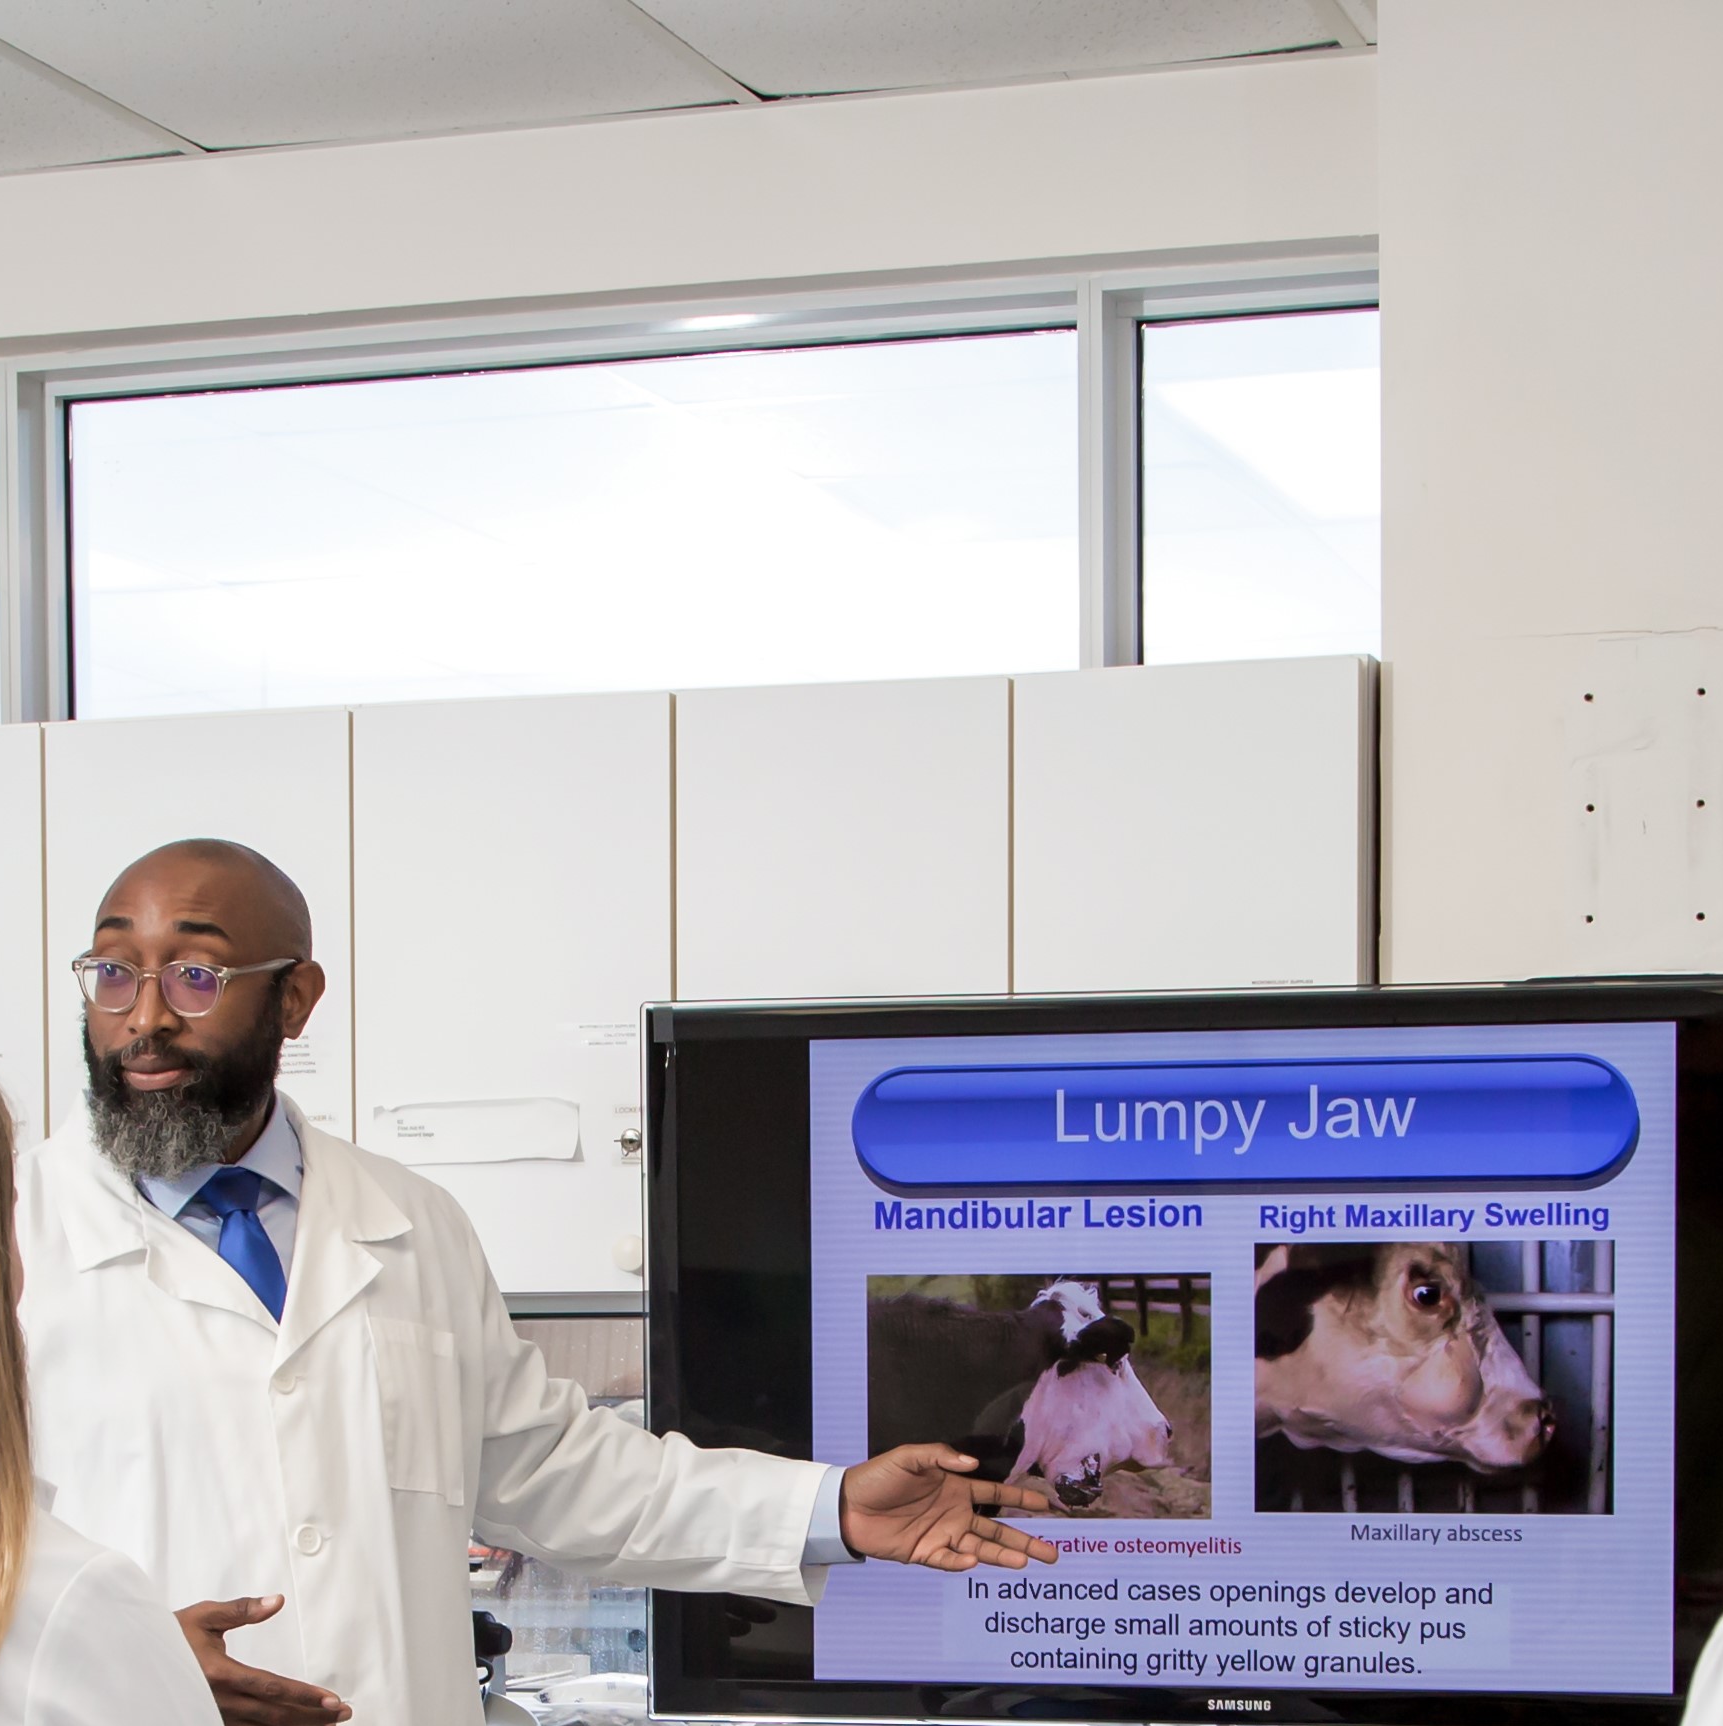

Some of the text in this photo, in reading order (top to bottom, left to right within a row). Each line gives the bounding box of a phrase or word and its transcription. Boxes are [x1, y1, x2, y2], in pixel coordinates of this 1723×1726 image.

[1056, 1084, 1417, 1155] Lumpy Jaw
[874, 1198, 1203, 1230] Mandibular Lesion
[1259, 1202, 1610, 1234] Right Maxillary Swelling
[1114, 1536, 1242, 1558] osteomyelitis
[1351, 1523, 1523, 1545] Maxillary abscess
[967, 1577, 1493, 1610] In advanced cases openings develop and
[984, 1611, 1466, 1645] discharge small amounts of sticky pus
[1010, 1647, 1423, 1679] containing gritty yellow granules.
[1207, 1699, 1272, 1711] SAMSUNG
